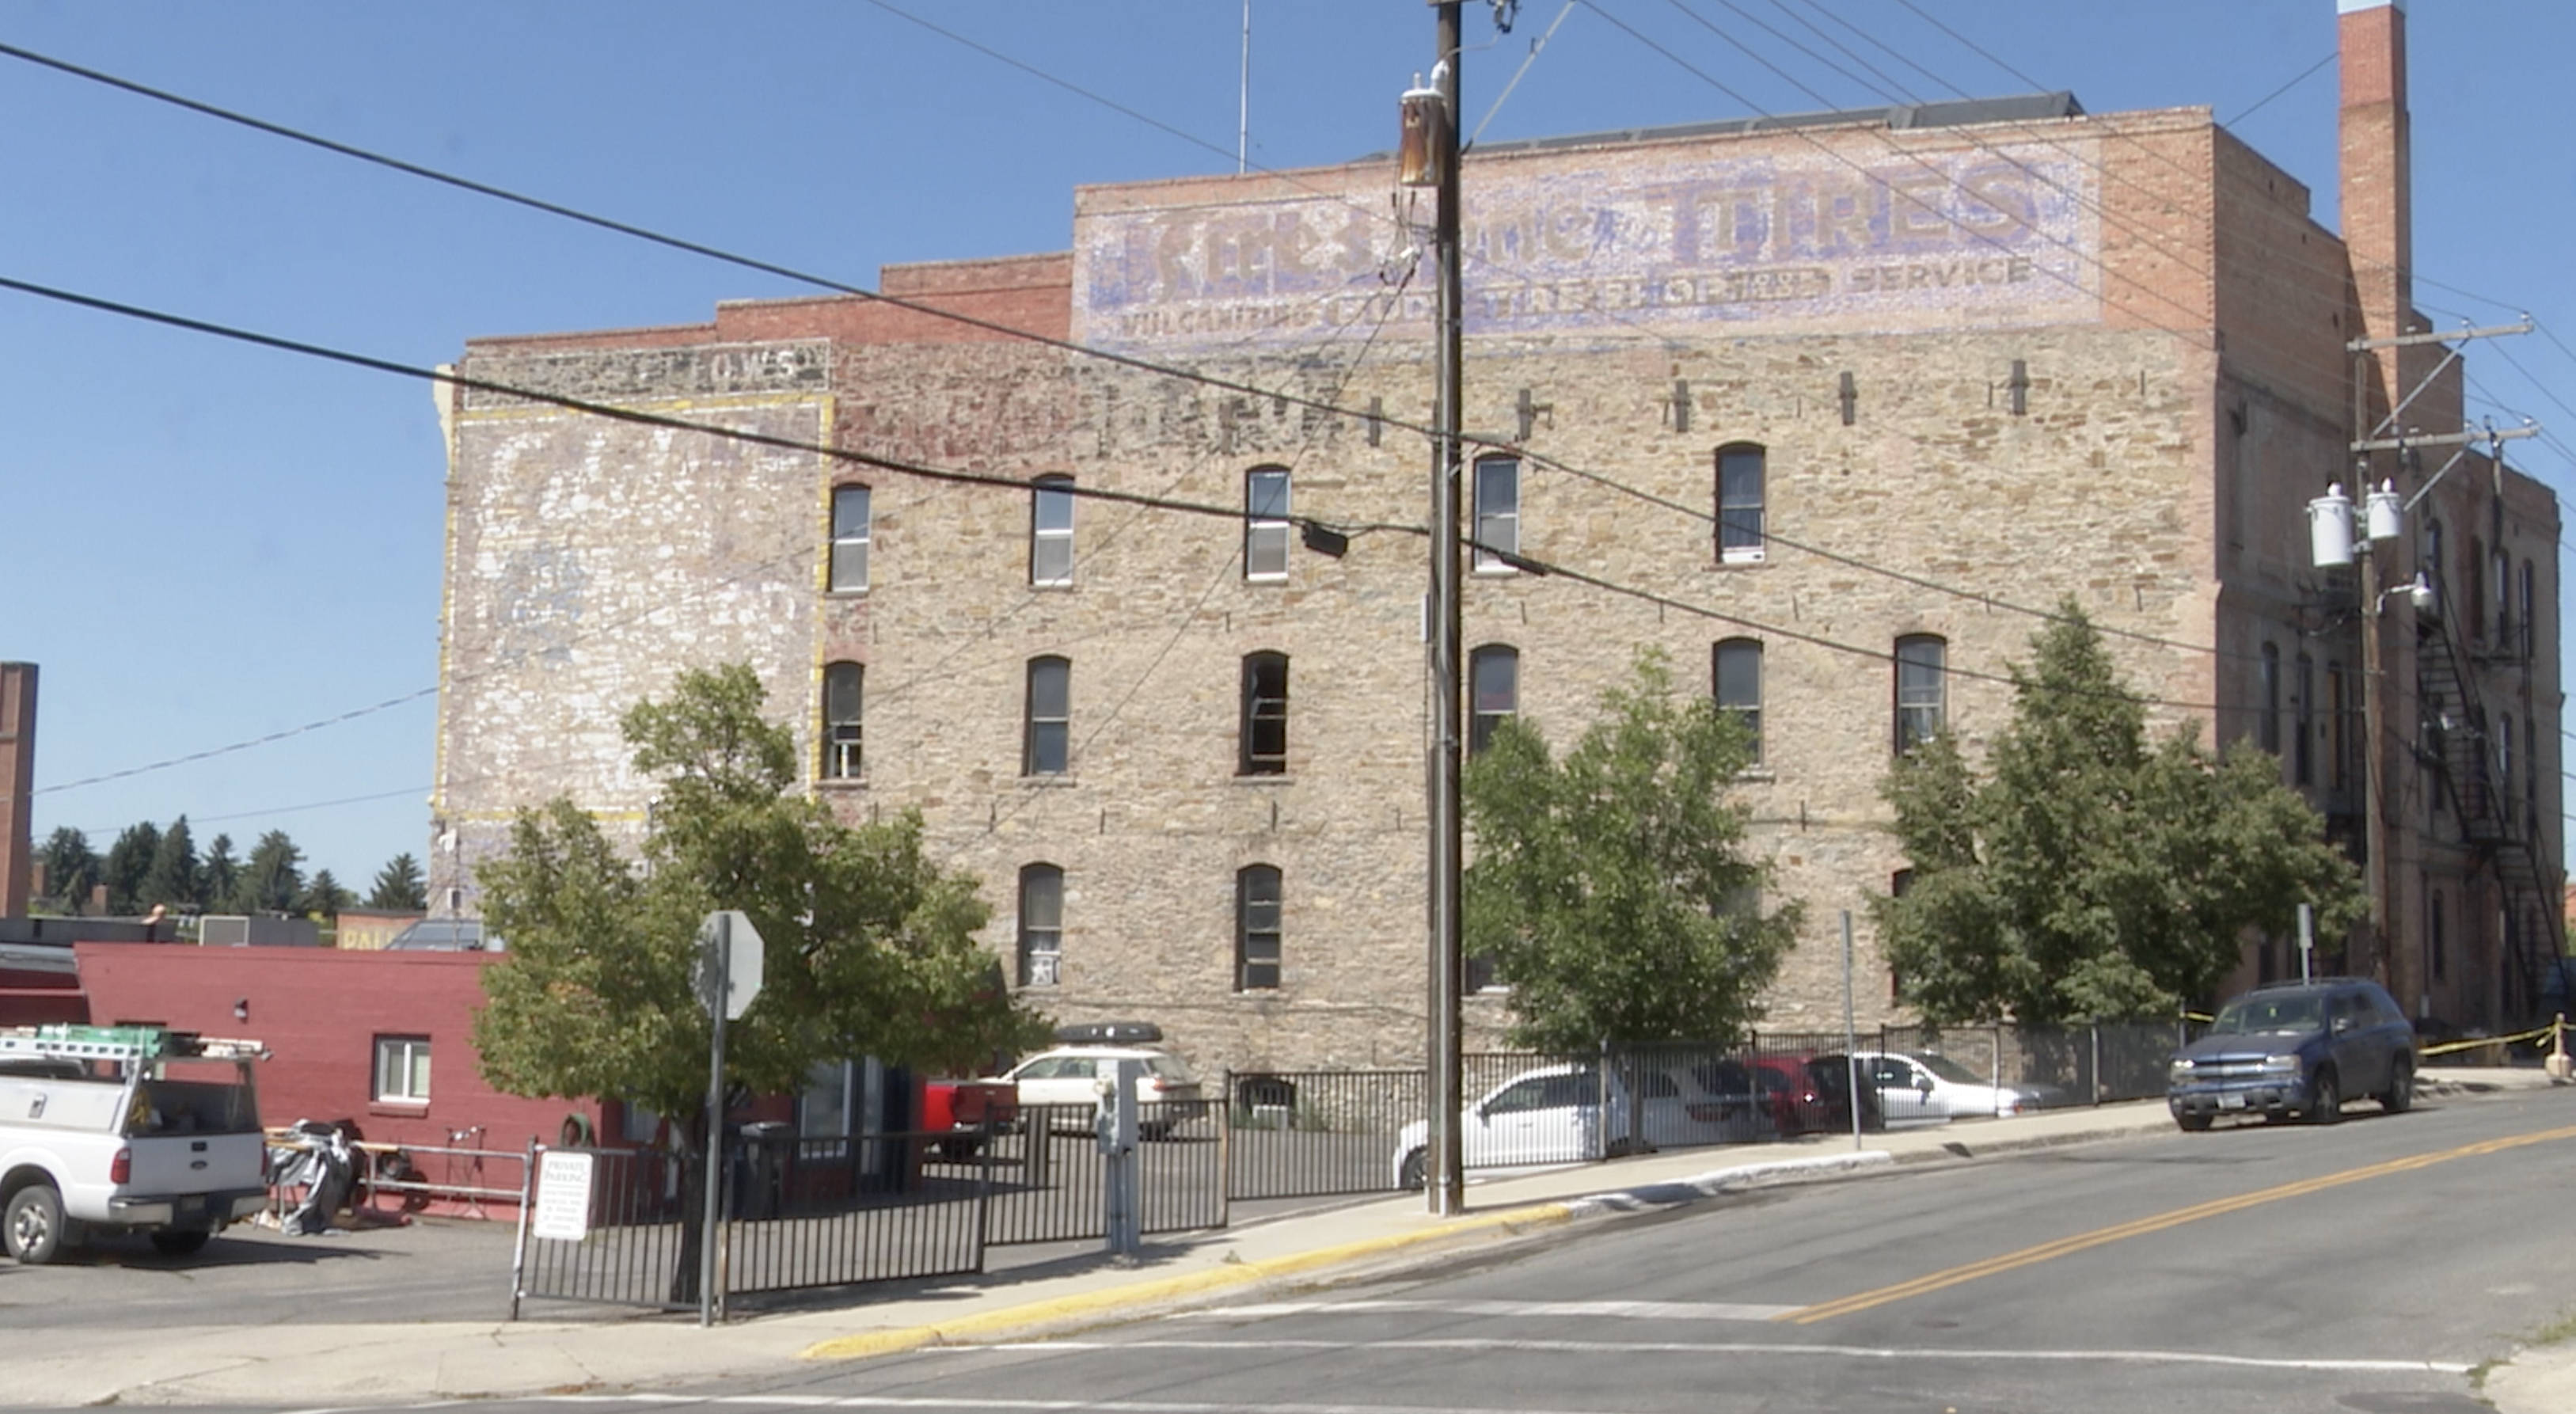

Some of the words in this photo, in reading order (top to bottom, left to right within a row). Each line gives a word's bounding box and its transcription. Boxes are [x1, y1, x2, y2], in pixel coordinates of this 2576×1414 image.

[1693, 158, 2033, 258] TIRES
[1848, 257, 2033, 294] SERVICE
[545, 1171, 587, 1183] PARKING
[548, 1160, 584, 1171] PRIVATE
